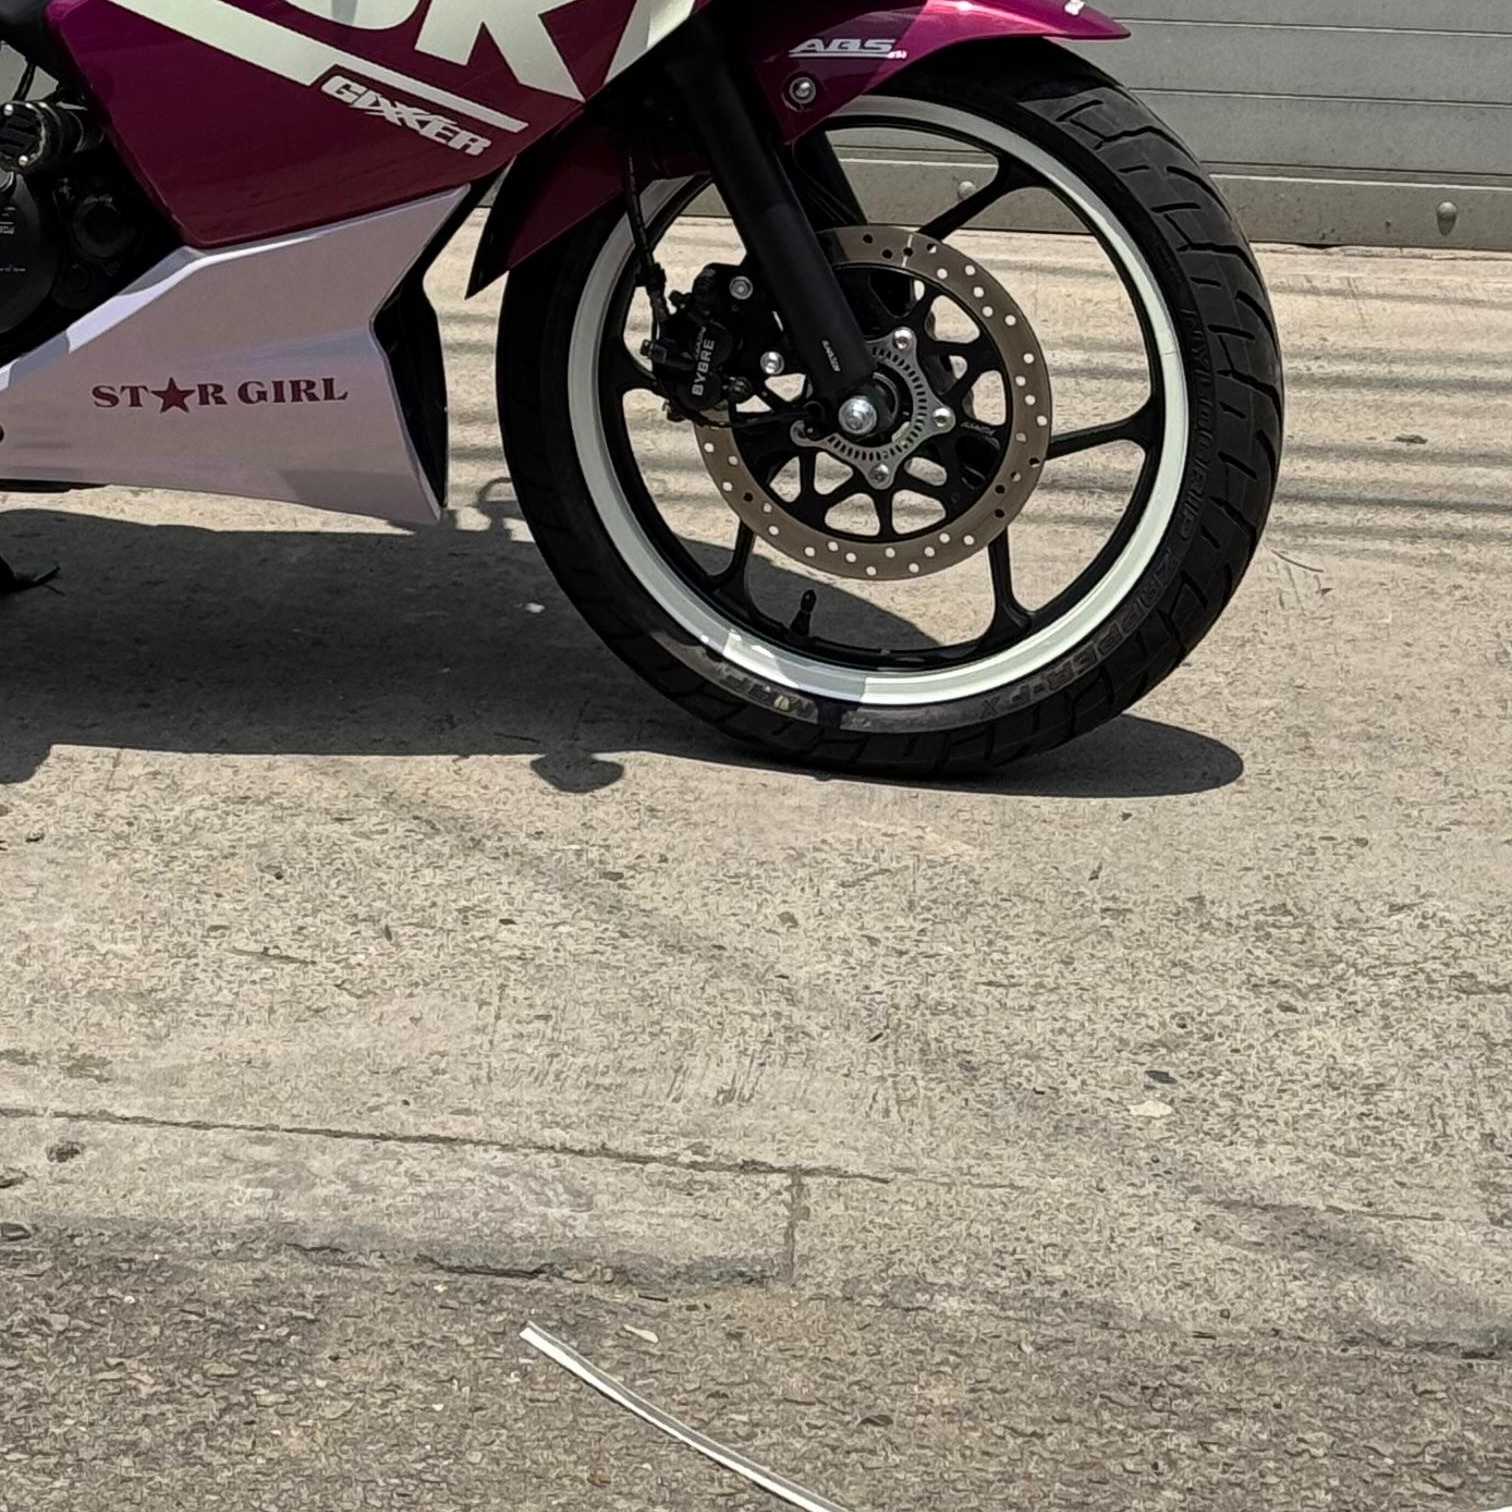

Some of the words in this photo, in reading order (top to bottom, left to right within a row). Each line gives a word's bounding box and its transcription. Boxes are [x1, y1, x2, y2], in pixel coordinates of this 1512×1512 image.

[788, 37, 896, 54] ABS
[320, 75, 492, 156] GIXXER
[691, 339, 715, 396] BYBRE
[237, 377, 349, 405] GIRL
